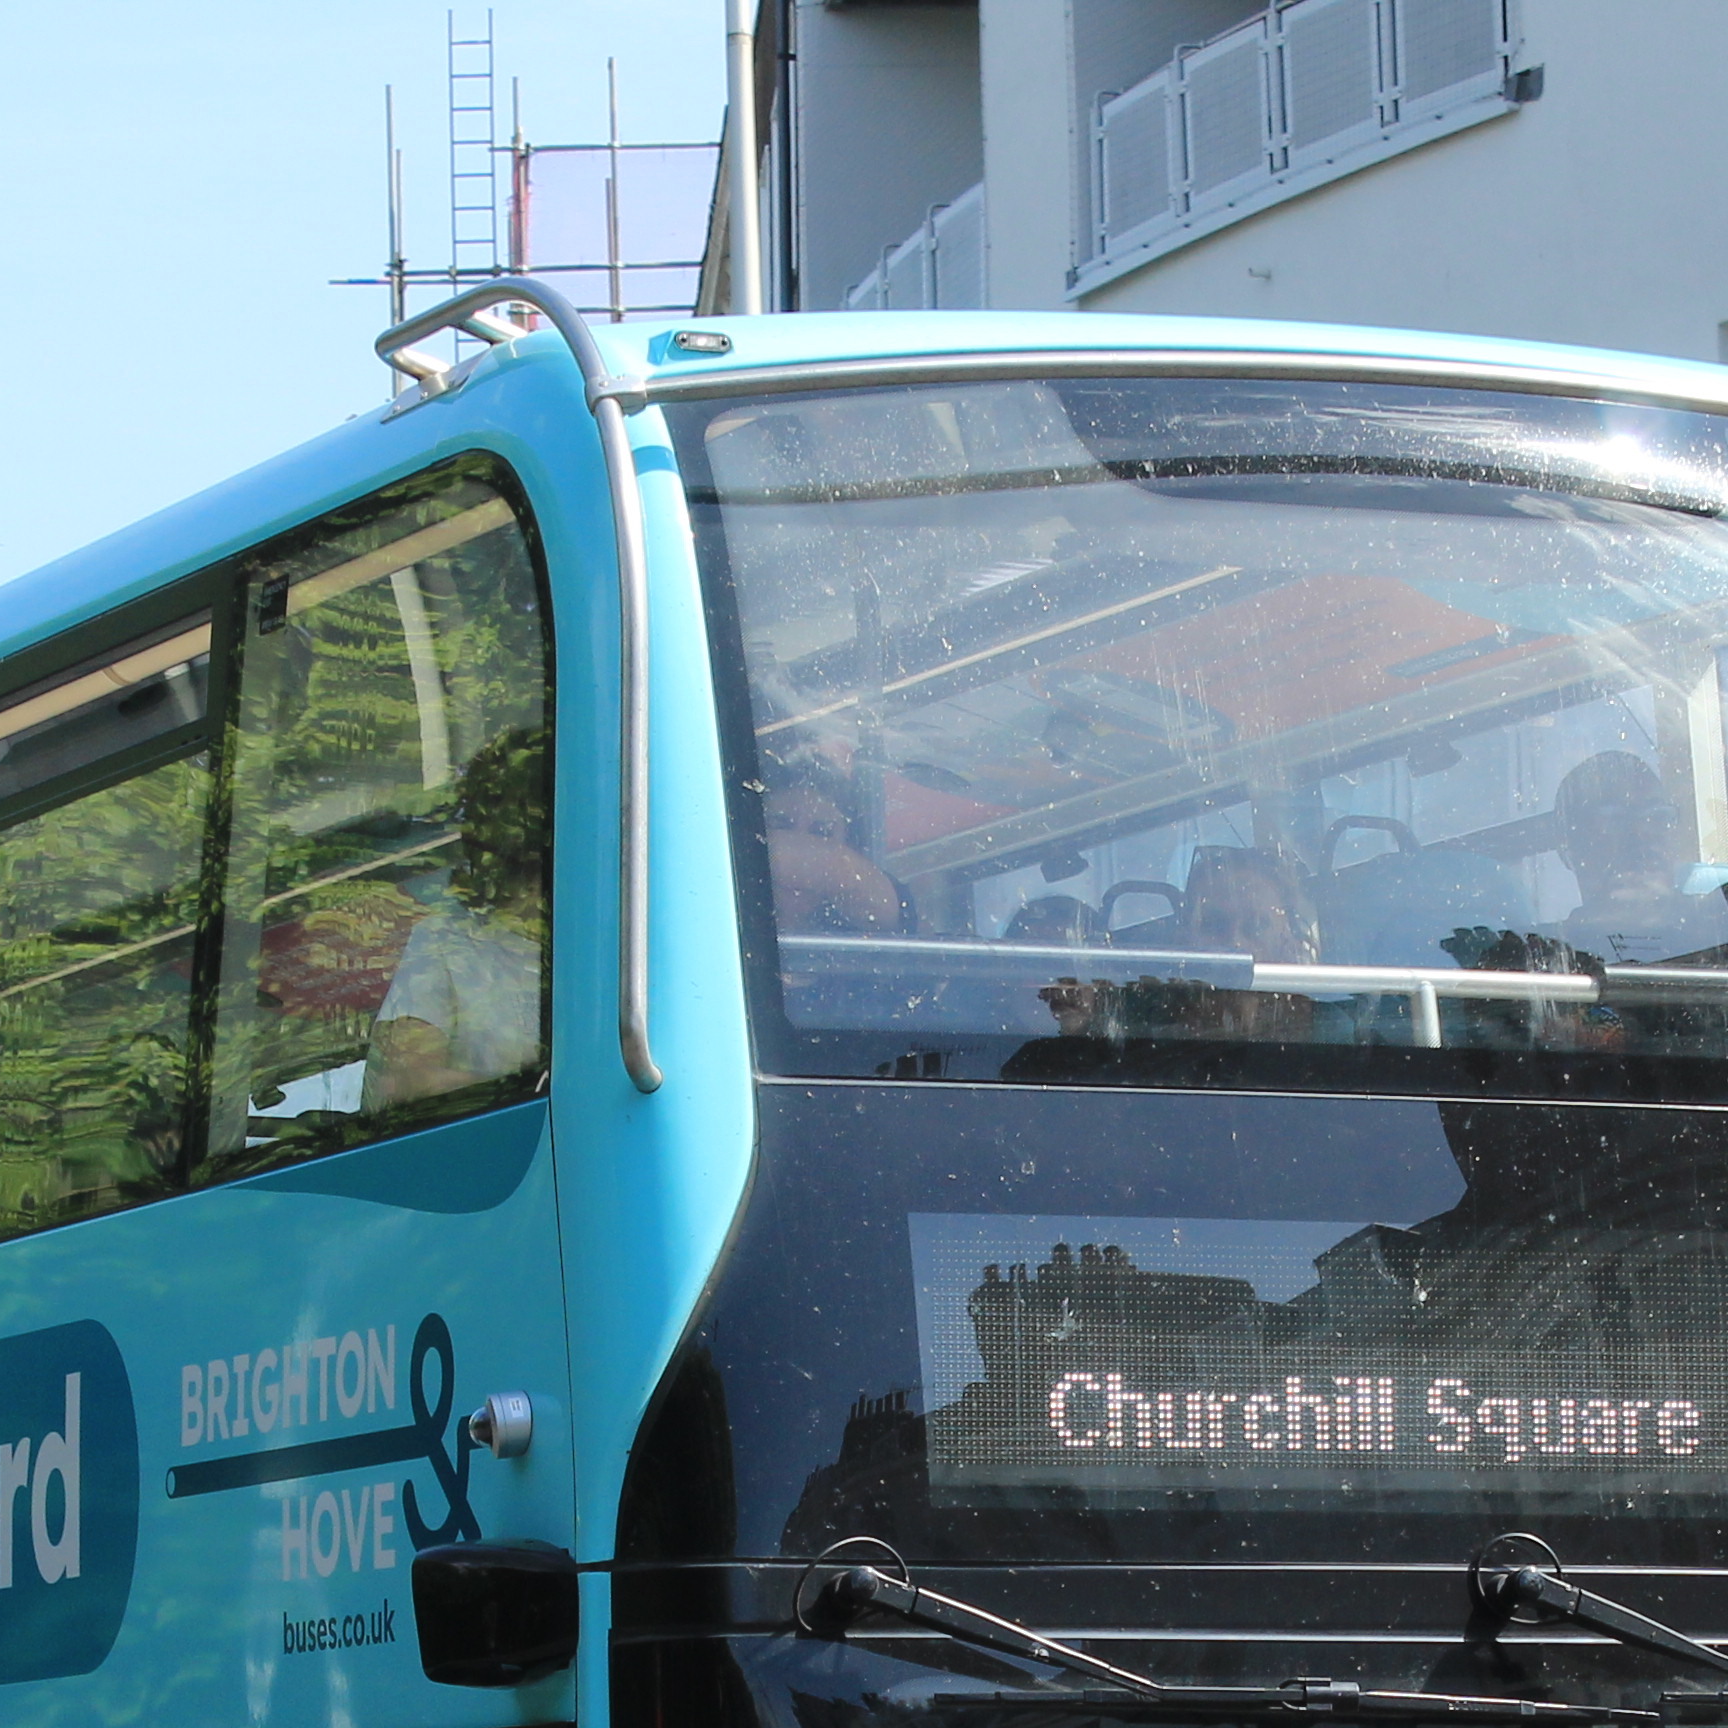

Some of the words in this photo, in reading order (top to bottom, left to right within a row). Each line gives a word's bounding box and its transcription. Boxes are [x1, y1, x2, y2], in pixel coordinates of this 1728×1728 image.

[181, 1325, 396, 1447] BRIGHTON
[1049, 1372, 1395, 1450] Churchill
[1427, 1378, 1701, 1462] Square
[282, 1482, 396, 1582] HOVE
[283, 1600, 396, 1656] buses.co.uk
